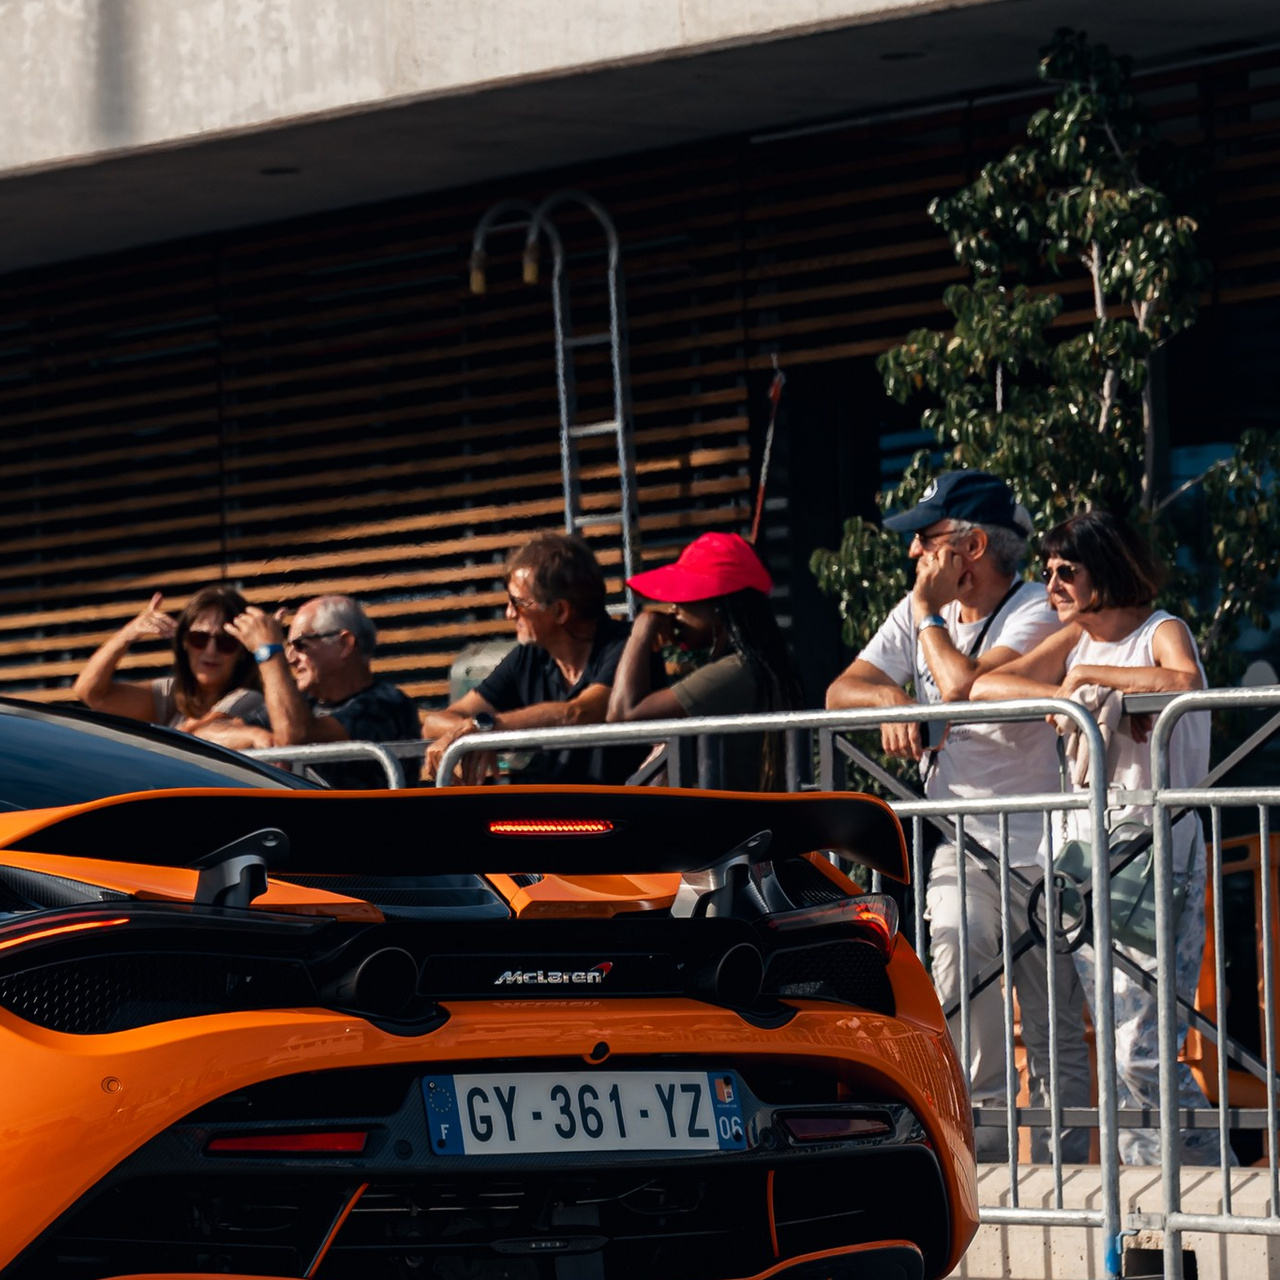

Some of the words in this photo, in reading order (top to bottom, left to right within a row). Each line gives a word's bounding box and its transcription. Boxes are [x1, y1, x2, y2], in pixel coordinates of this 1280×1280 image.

[493, 970, 602, 985] McLaren
[440, 1123, 449, 1140] F
[719, 1115, 743, 1140] 06
